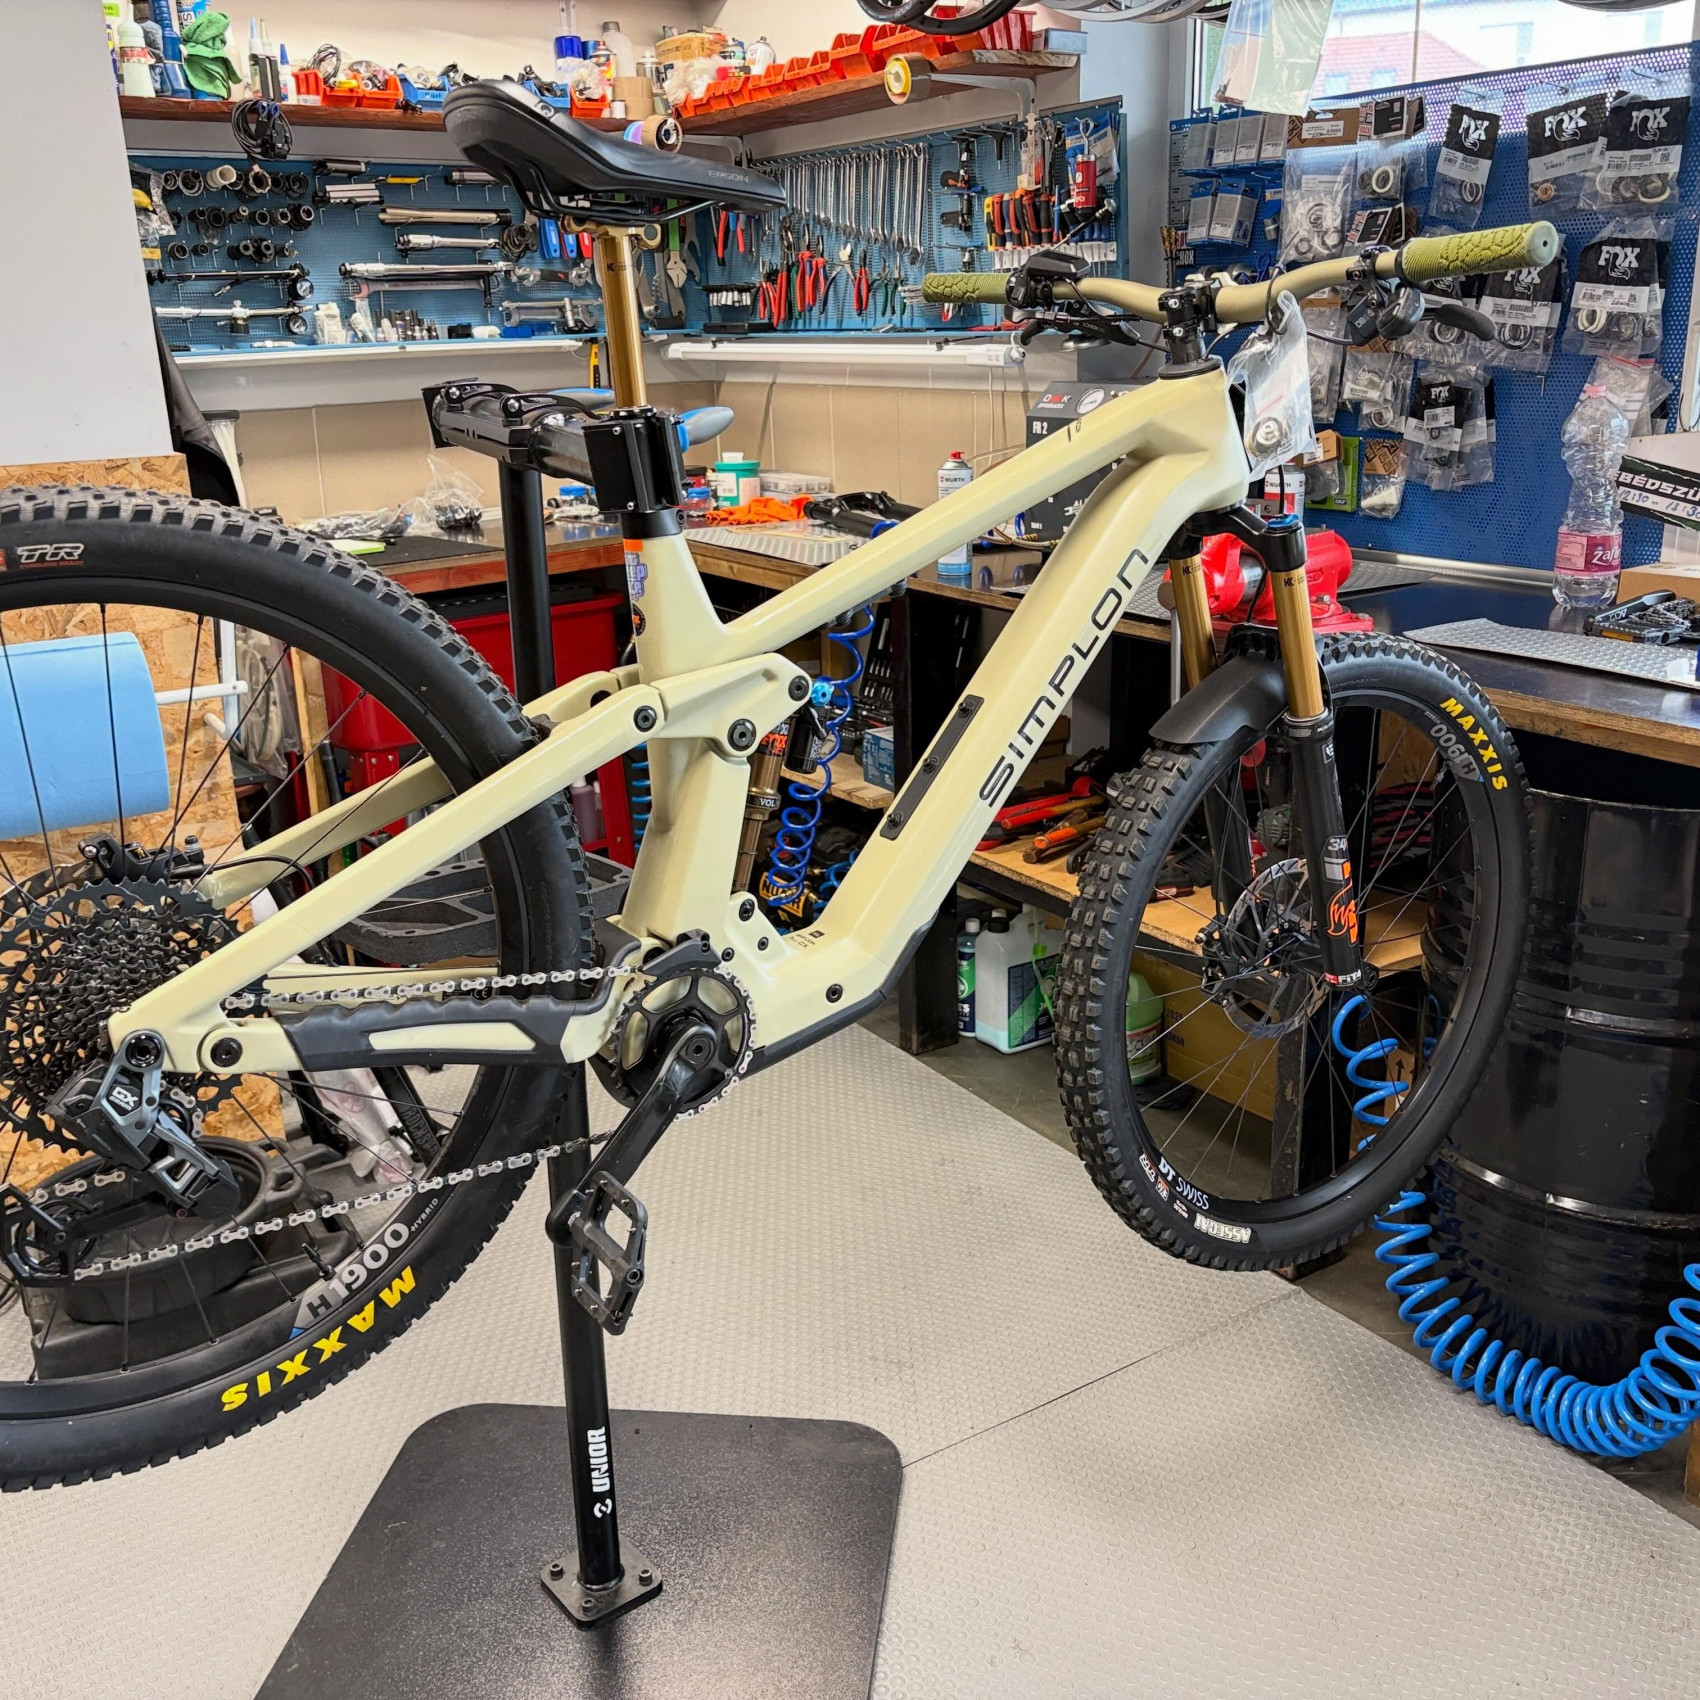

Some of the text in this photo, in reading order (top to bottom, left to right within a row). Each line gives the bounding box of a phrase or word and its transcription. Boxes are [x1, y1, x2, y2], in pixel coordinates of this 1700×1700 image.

[1457, 114, 1490, 151] FOX
[1544, 106, 1587, 141] FOX
[1629, 106, 1670, 141] FOX
[708, 170, 749, 183] ERGON
[1597, 245, 1641, 280] FOX
[1430, 385, 1450, 403] FOX
[1032, 421, 1048, 434] FR 2
[17, 542, 84, 563] TR
[979, 548, 1149, 808] SIMPLON
[1430, 724, 1477, 775] H1900
[1439, 697, 1508, 791] MAXXIS
[1327, 838, 1347, 851] 34
[111, 1086, 139, 1107] GX
[1157, 1155, 1176, 1182] DT
[1175, 1177, 1210, 1210] SWISS
[1193, 1212, 1252, 1244] ASSEGAI
[306, 1222, 410, 1319] H1900
[221, 1265, 417, 1412] MAXXIS
[587, 1425, 611, 1493] UNIOR
